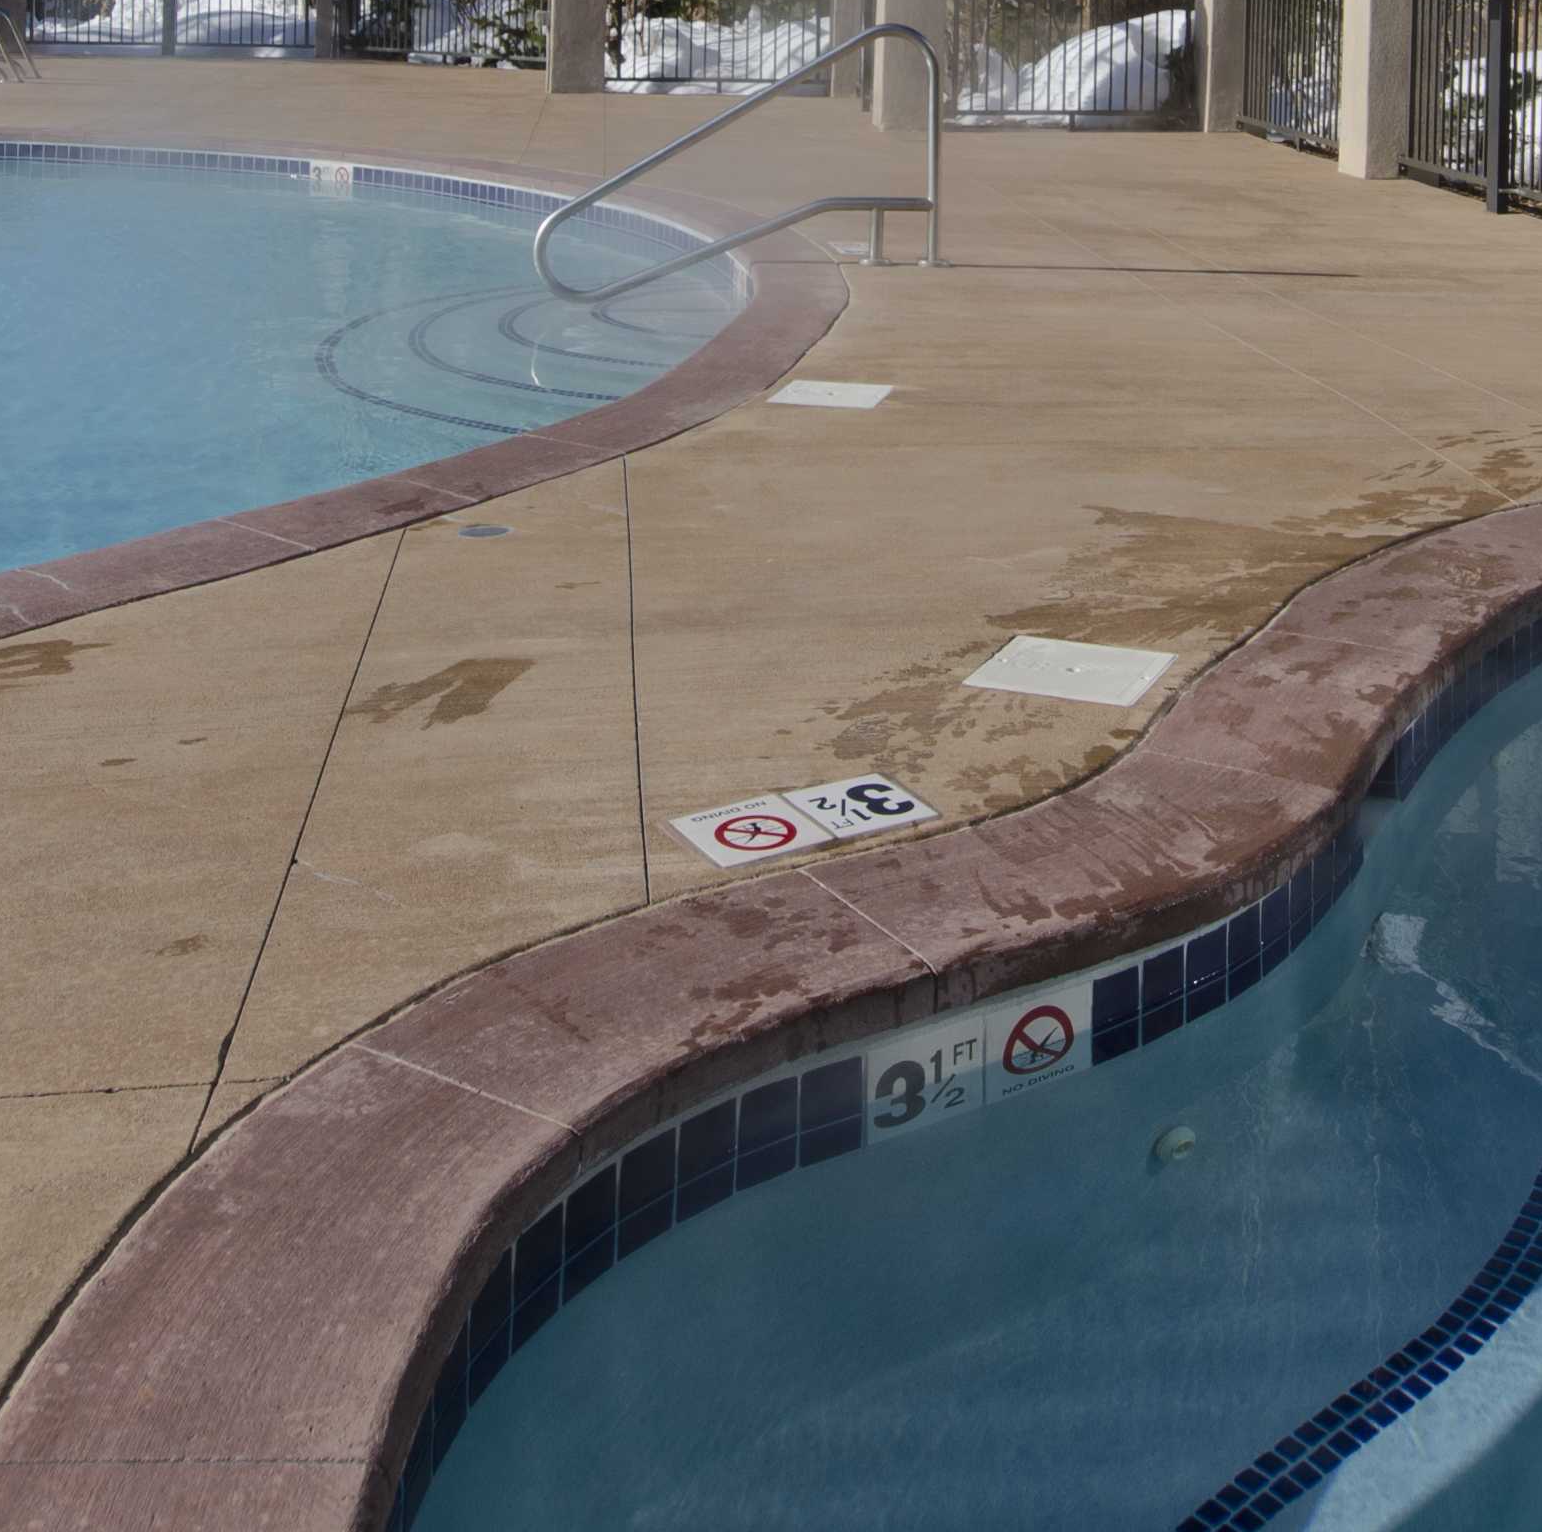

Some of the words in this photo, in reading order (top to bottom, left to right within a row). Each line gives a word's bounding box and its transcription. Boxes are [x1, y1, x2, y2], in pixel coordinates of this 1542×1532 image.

[744, 801, 767, 810] NO
[846, 783, 915, 816] 3
[690, 806, 741, 823] DIVING
[831, 818, 855, 829] FT
[953, 1038, 977, 1066] FT
[1001, 1083, 1024, 1096] NO
[1027, 1064, 1075, 1086] DIVING
[873, 1060, 926, 1129] 3
